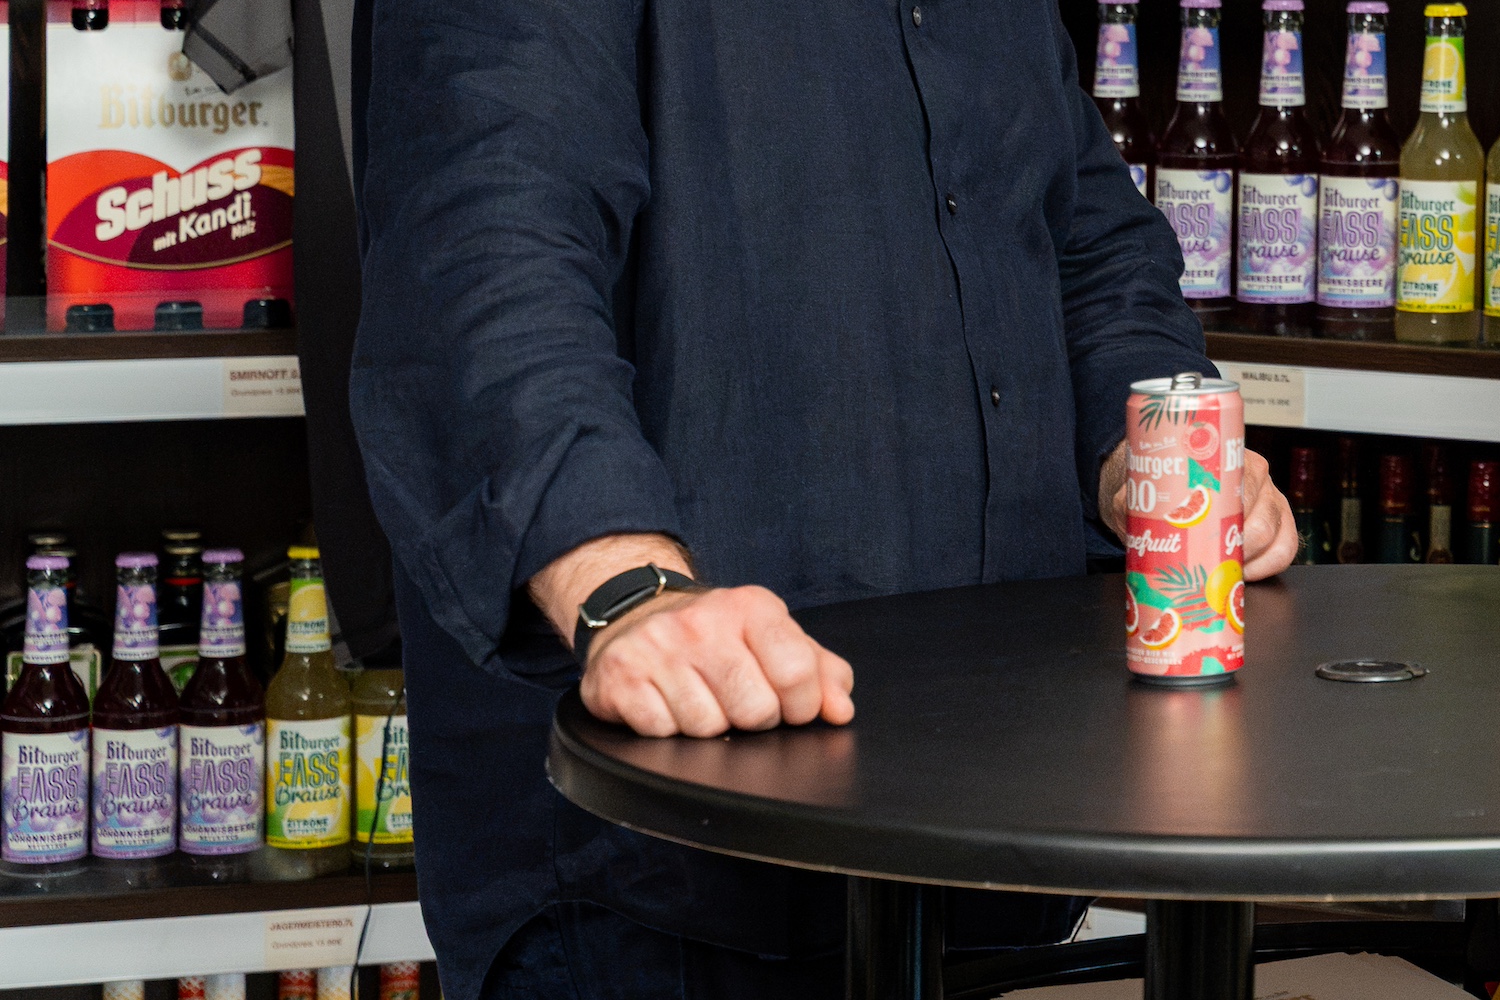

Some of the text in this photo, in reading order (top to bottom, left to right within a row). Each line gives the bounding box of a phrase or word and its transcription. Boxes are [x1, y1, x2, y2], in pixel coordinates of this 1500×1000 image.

[98, 84, 265, 135] Bitburger
[95, 148, 263, 242] Schuss
[153, 193, 253, 252] mit Kandi
[1127, 479, 1157, 513] 0.0
[18, 745, 79, 766] Bitburger
[106, 741, 166, 761] Bitburger
[191, 737, 251, 757] Bitburger
[280, 730, 340, 750] Bitburger
[17, 765, 79, 805] FASS
[105, 761, 166, 800] FASS
[190, 758, 250, 796] FASS
[279, 751, 339, 789] FASS
